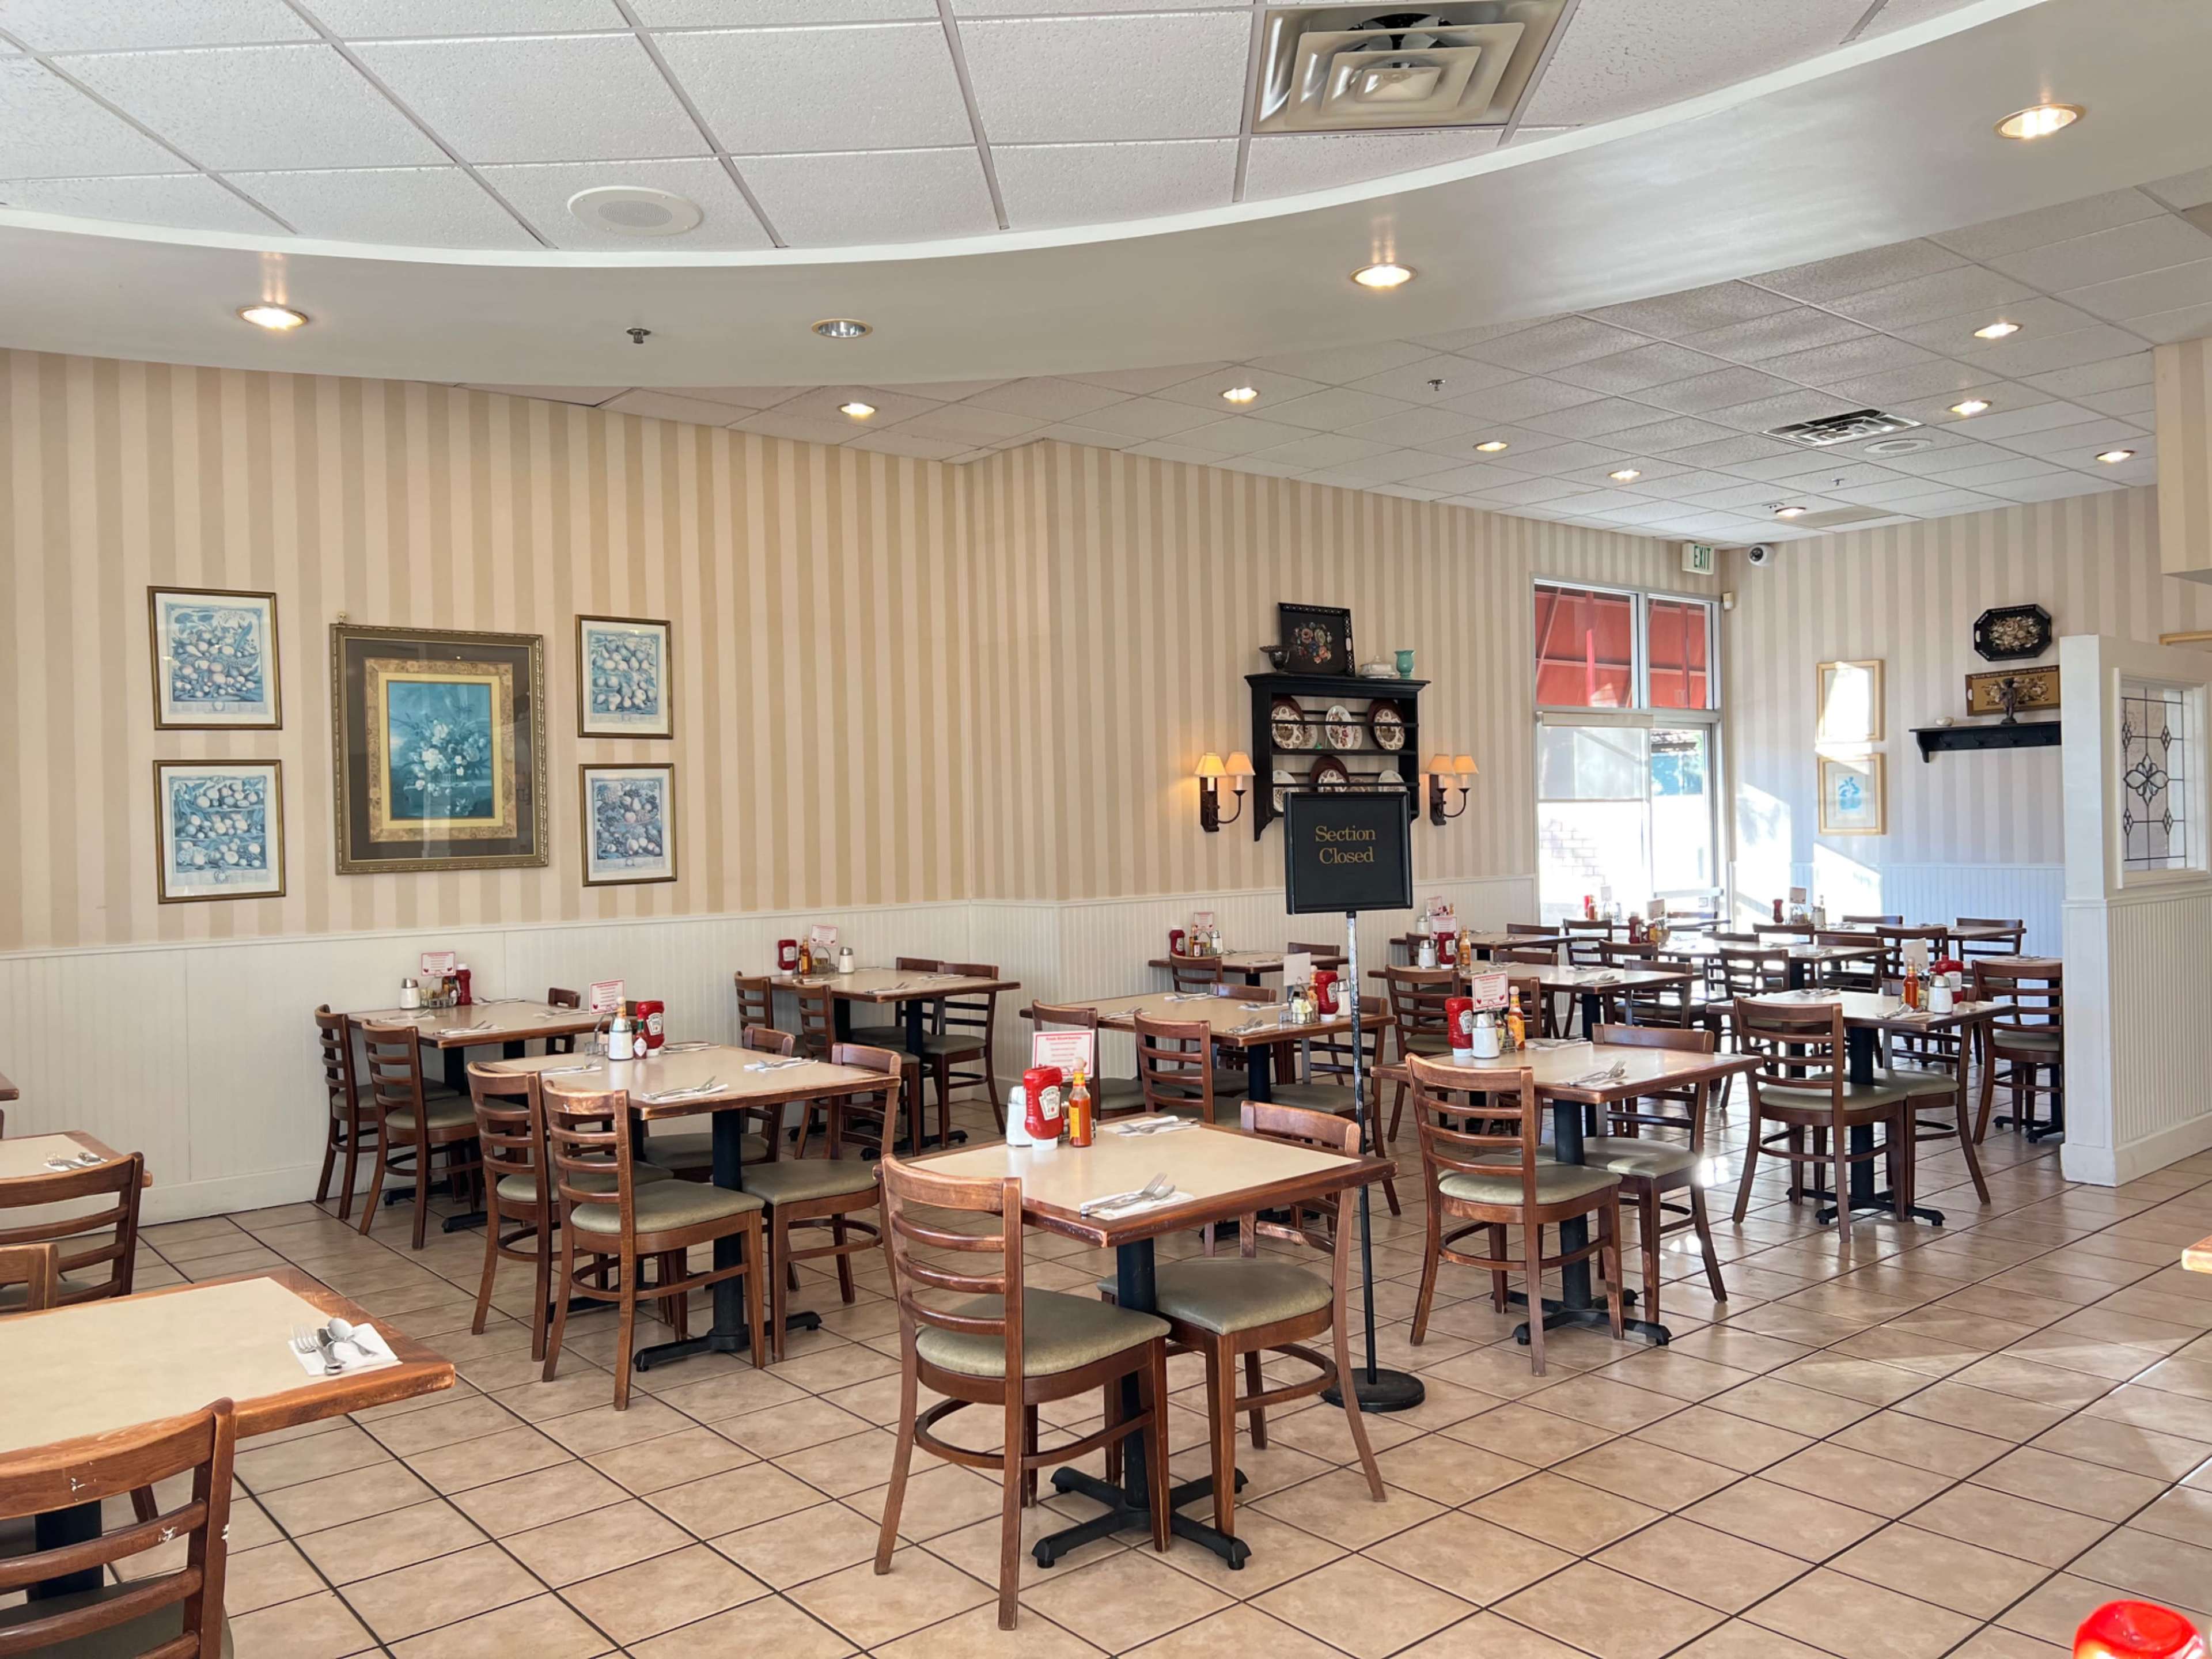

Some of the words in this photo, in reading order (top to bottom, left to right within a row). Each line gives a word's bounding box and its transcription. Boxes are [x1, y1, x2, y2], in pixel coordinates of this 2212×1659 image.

[1694, 545, 1711, 570] EXIT
[1315, 825, 1376, 842] Section
[1319, 846, 1375, 864] Closed
